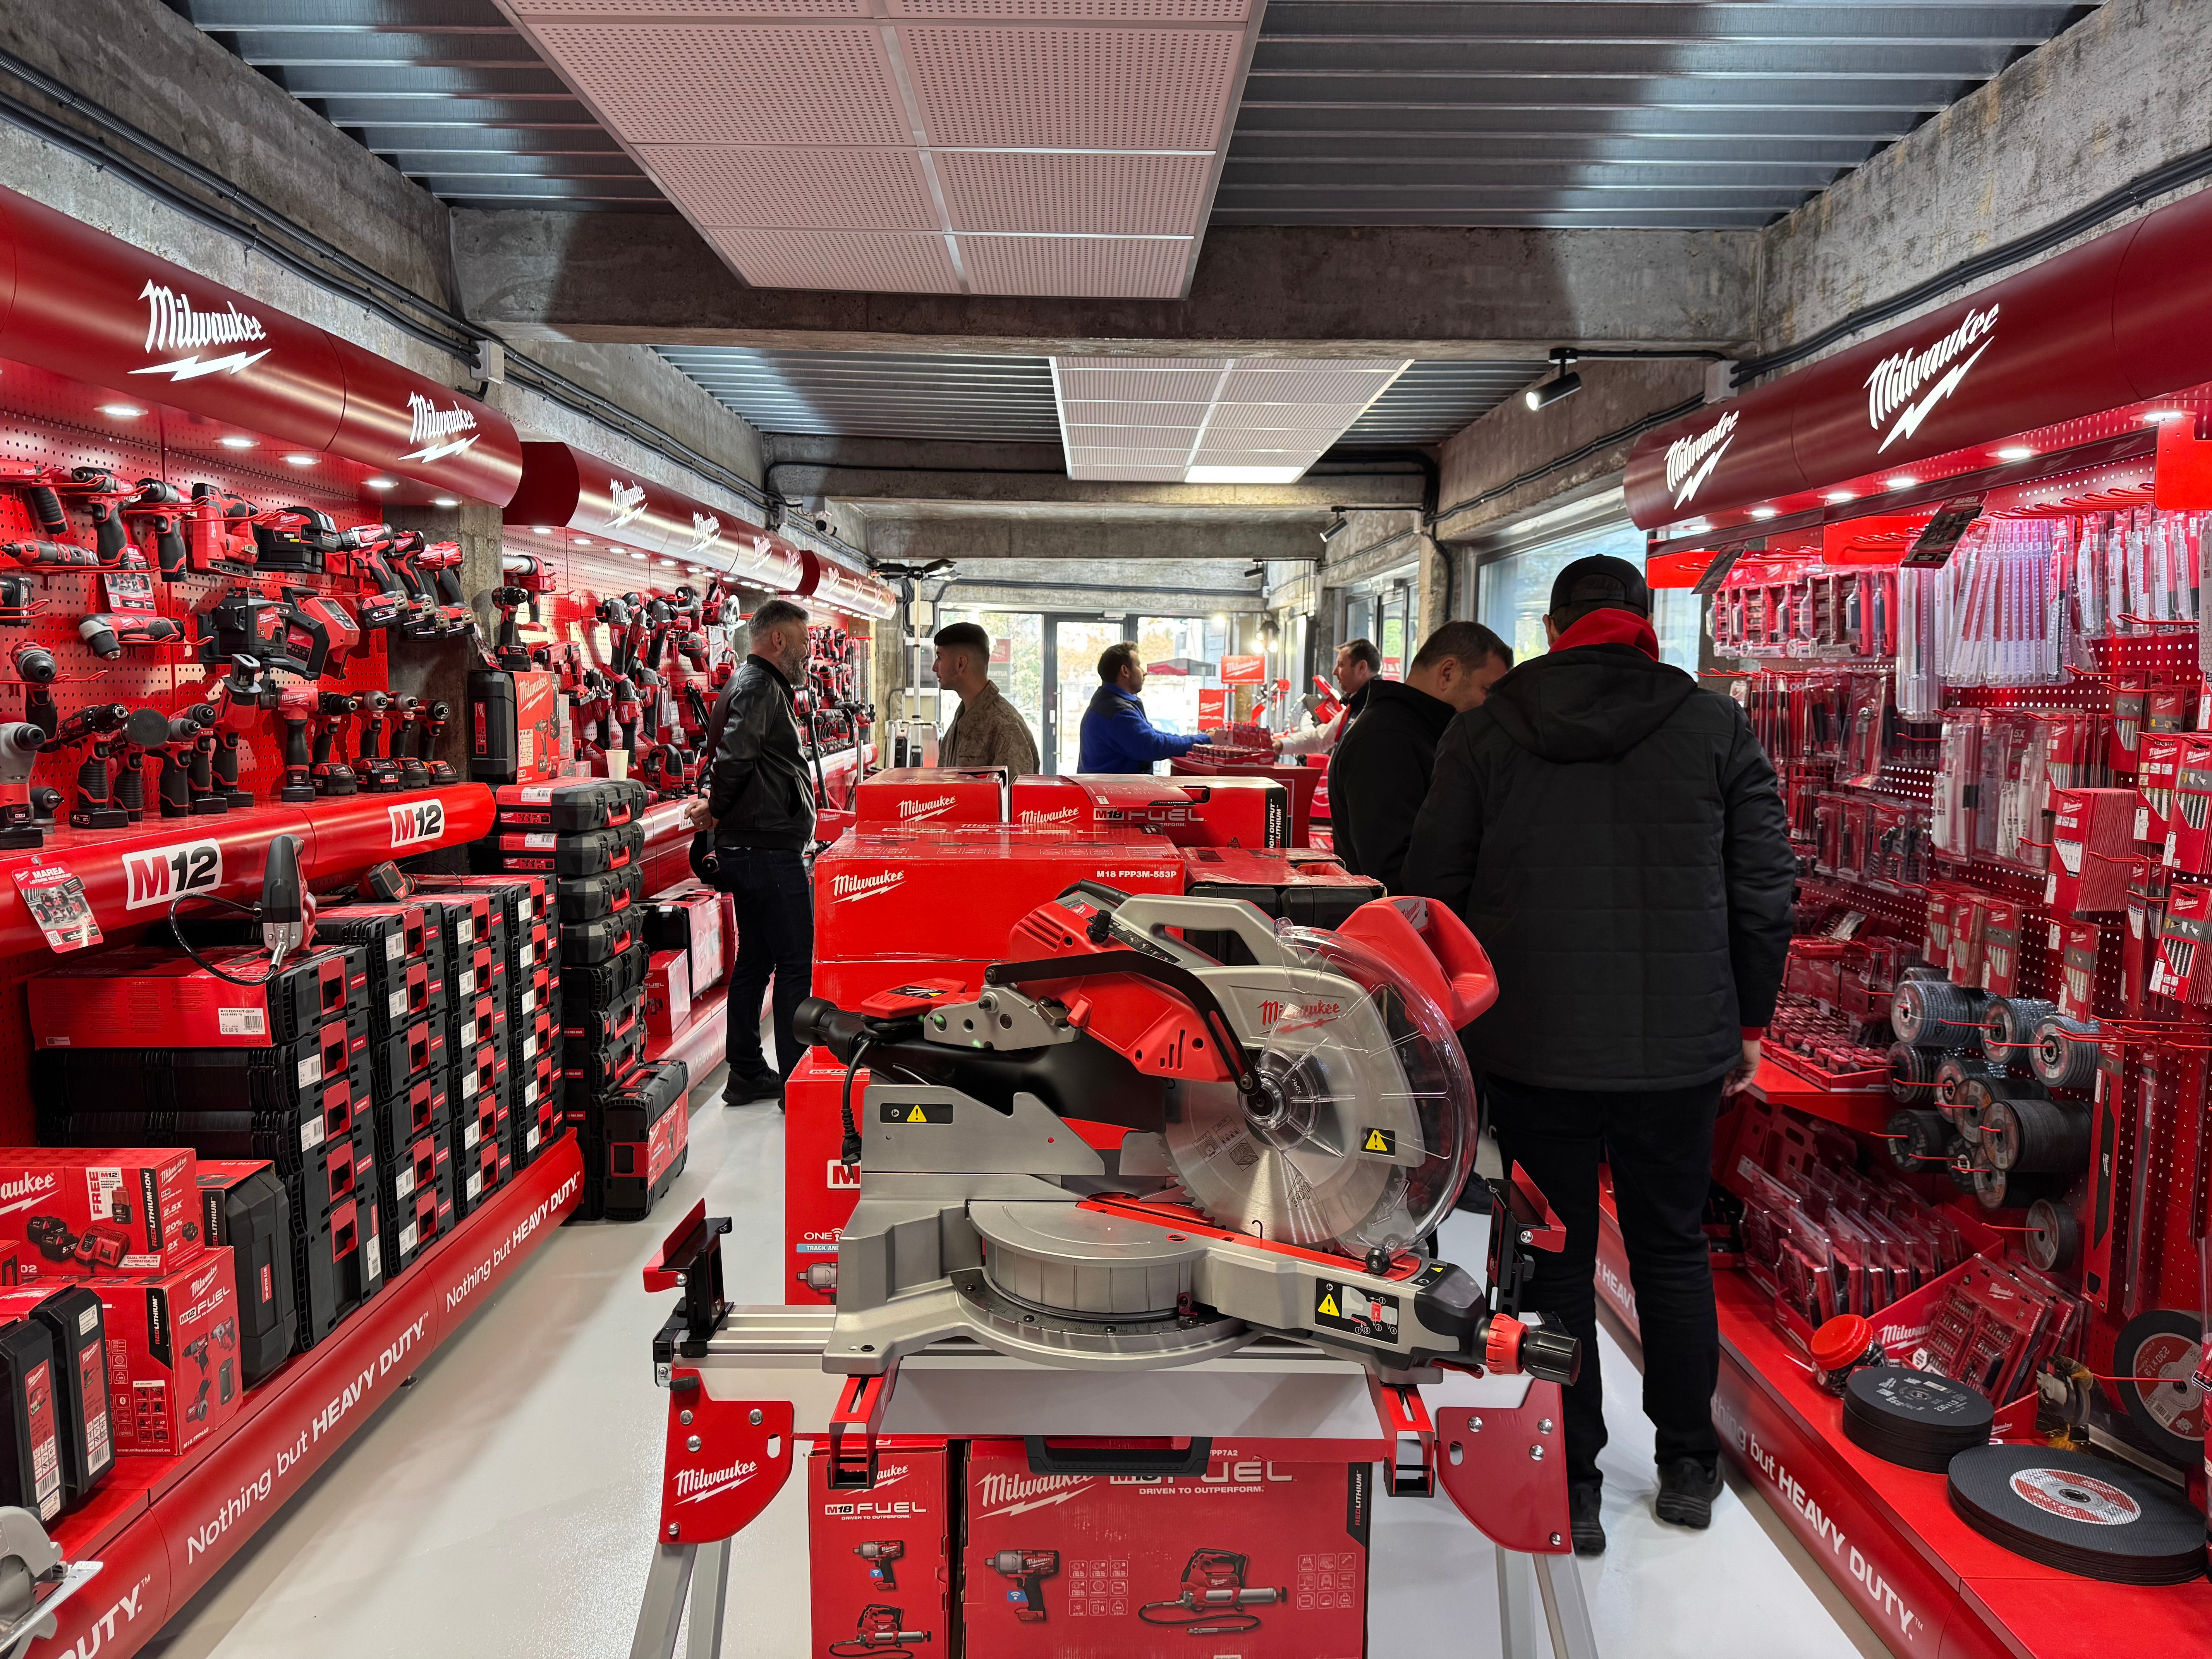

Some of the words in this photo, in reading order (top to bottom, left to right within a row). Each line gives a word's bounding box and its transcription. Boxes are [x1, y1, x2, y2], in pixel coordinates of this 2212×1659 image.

[137, 278, 267, 353] Milwaukee
[1863, 304, 1999, 430] Milwaukee
[407, 390, 477, 444] Milwaukee
[1664, 410, 1739, 492] Milwaukee
[610, 478, 646, 516] Milwaukee
[518, 674, 548, 705] Milwaukee
[2148, 747, 2177, 757] Milwaukee
[895, 795, 956, 818] Milwaukee
[1017, 806, 1079, 823] Milwaukee
[1096, 810, 1123, 820] M18
[1128, 809, 1204, 821] FUEL
[393, 805, 442, 842] M12
[33, 867, 65, 880] MAREA
[130, 846, 218, 902] M12
[829, 870, 904, 896] Milwaukee
[1257, 999, 1340, 1026] Miaukee
[160, 1157, 187, 1183] Milwaukee
[1, 1171, 56, 1200] aukee
[89, 1171, 103, 1214] FREE
[144, 1171, 158, 1247] REDLITHIUM-ION
[165, 1219, 183, 1235] 20%
[167, 1240, 178, 1252] 2X
[447, 1259, 490, 1312] Nothing
[493, 1239, 510, 1267] but
[512, 1199, 549, 1249] HEAVY
[190, 1264, 218, 1297] Milwaukee
[181, 1309, 196, 1324] M12
[197, 1286, 230, 1316] FUEL
[2030, 1308, 2042, 1331] IMPACT
[1878, 1324, 1932, 1345] Milwau
[2059, 1308, 2071, 1332] IMPACT
[187, 1468, 271, 1565] Nothing
[277, 1430, 308, 1477] but
[312, 1371, 376, 1443] HEAVY
[672, 1460, 757, 1497] Milwaukee
[877, 1465, 908, 1480] aukee
[1712, 1394, 1746, 1451] thing
[1750, 1433, 1775, 1480] but
[1779, 1466, 1846, 1555] HEAVY
[1194, 1486, 1264, 1494] OUTPERFORM.
[826, 1506, 852, 1514] M18
[857, 1502, 927, 1515] FUEL
